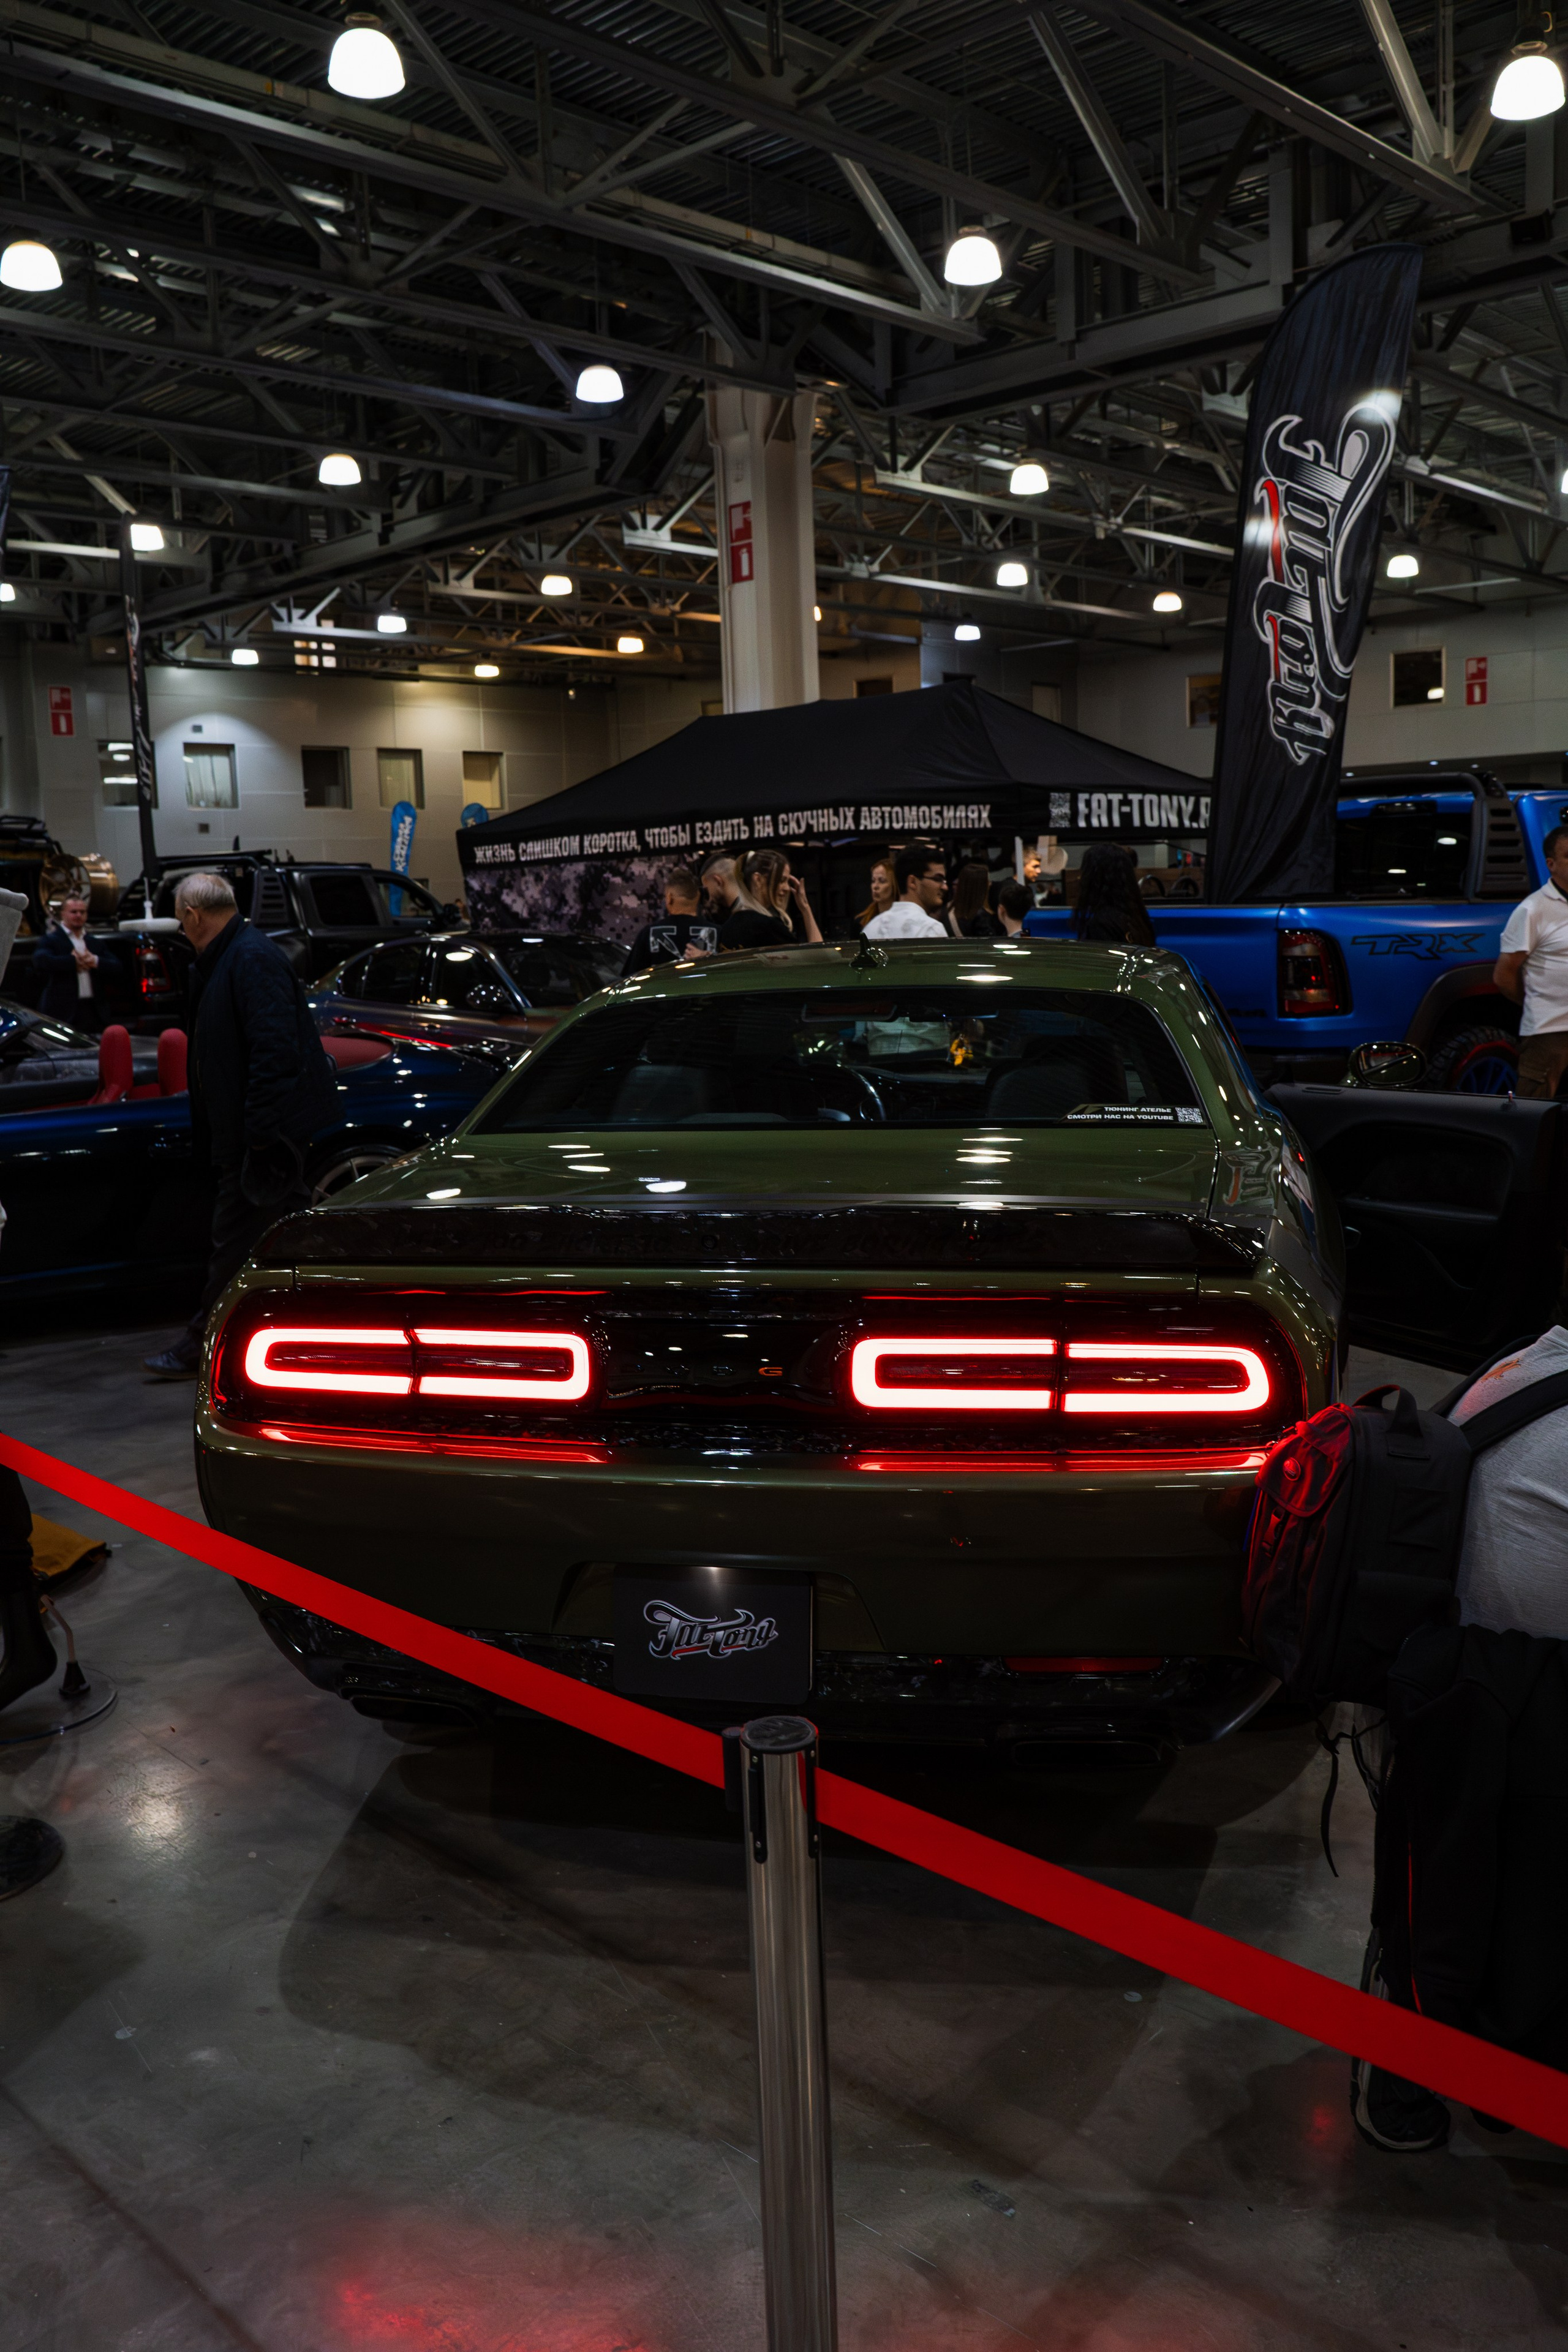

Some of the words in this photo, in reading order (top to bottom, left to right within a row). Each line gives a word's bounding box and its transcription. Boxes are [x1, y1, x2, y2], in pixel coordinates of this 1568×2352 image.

[474, 843, 516, 864] ЖИЗНЬ
[519, 835, 581, 862] СЛИШКОМ
[583, 830, 641, 854] КОРОТКА,
[645, 823, 690, 849] ЧТОБЫ
[695, 818, 749, 846] ЕЗДИТЬ
[753, 815, 774, 838] НА
[778, 807, 856, 836] СКУЧНЫХ
[859, 804, 992, 831] АВТОМОБИЛЯХ
[1351, 933, 1485, 960] TRX
